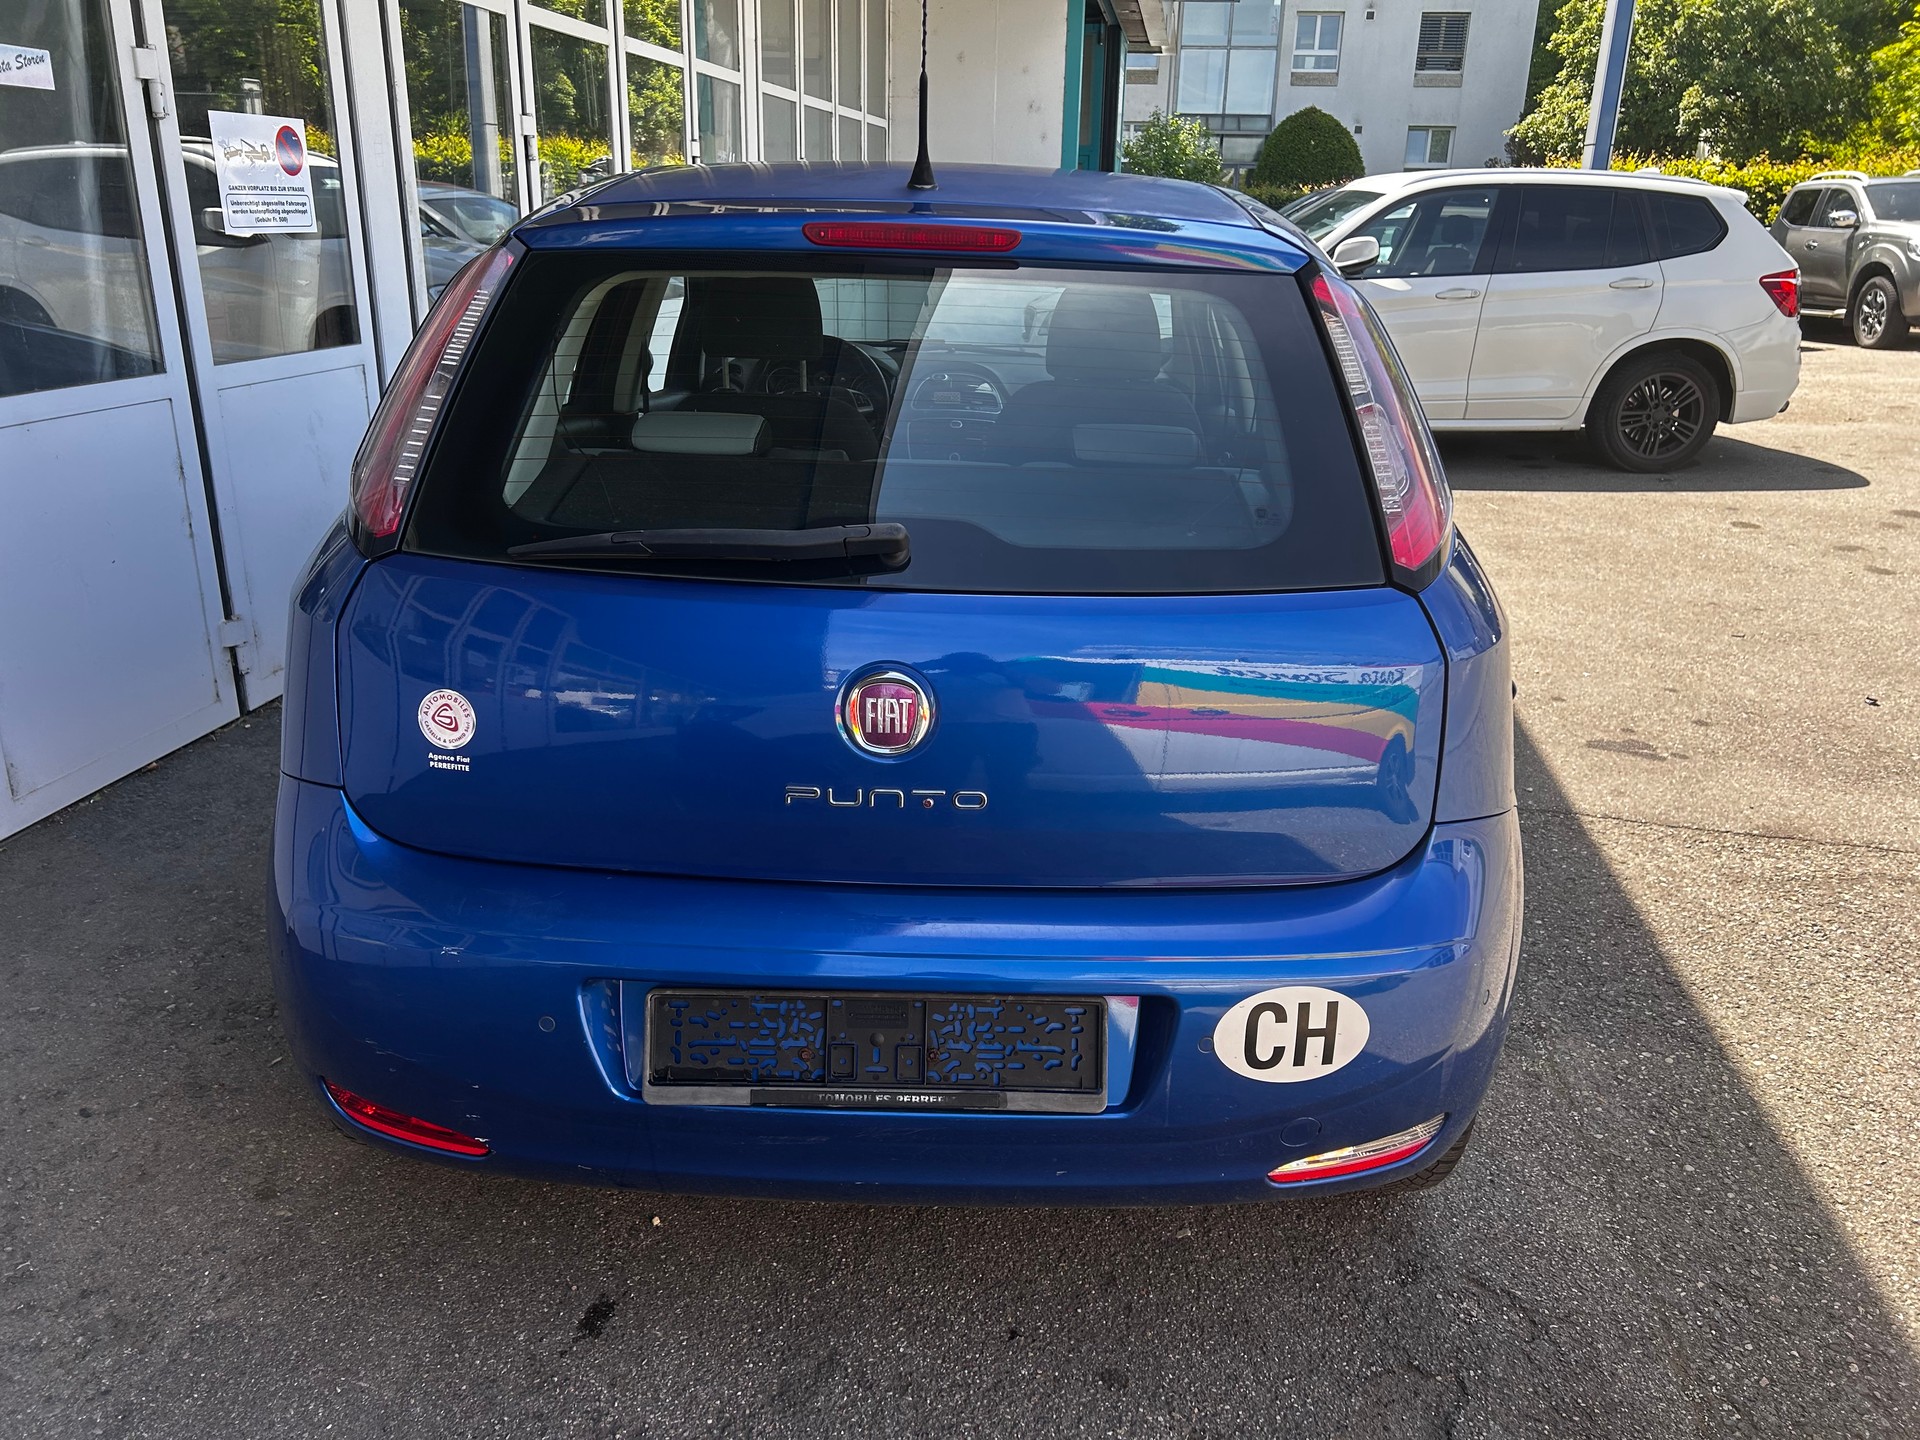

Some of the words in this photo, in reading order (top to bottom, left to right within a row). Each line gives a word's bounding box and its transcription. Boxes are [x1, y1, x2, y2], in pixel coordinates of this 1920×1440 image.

[15, 54, 45, 70] Storen
[423, 694, 471, 718] AUTOMOBILES
[865, 698, 913, 734] FIAT
[424, 720, 442, 742] CASSELLA
[448, 732, 466, 744] SCHMID
[428, 752, 455, 762] Agence
[456, 755, 470, 763] Fiat
[429, 761, 470, 772] PERREFITTE
[784, 785, 989, 810] PUNTO
[1244, 1001, 1339, 1070] CH
